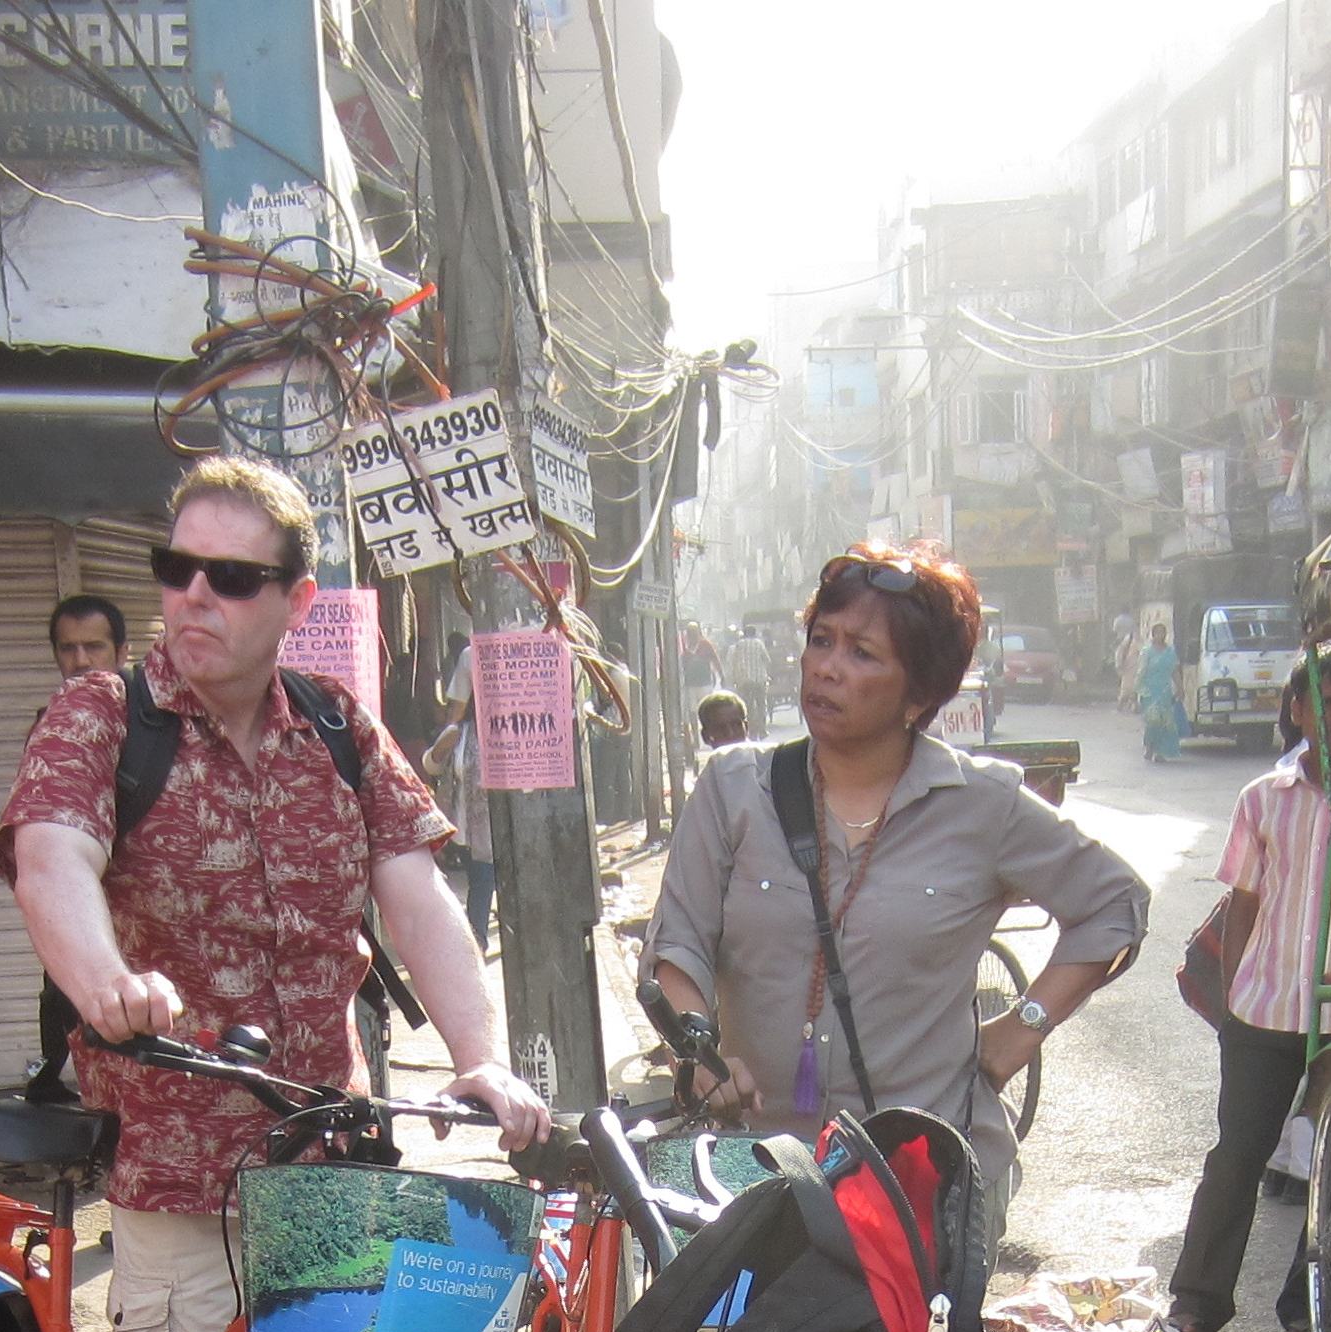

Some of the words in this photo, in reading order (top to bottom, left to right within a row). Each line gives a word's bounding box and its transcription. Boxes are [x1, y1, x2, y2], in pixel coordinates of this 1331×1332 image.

[341, 401, 501, 474] 9990343930
[291, 626, 362, 638] MONTH
[311, 640, 359, 651] CAMP
[505, 659, 559, 670] MONTH
[520, 670, 556, 680] CAMP
[401, 1249, 443, 1271] We're
[446, 1260, 466, 1274] on
[467, 1262, 477, 1277] a
[397, 1271, 415, 1289] to
